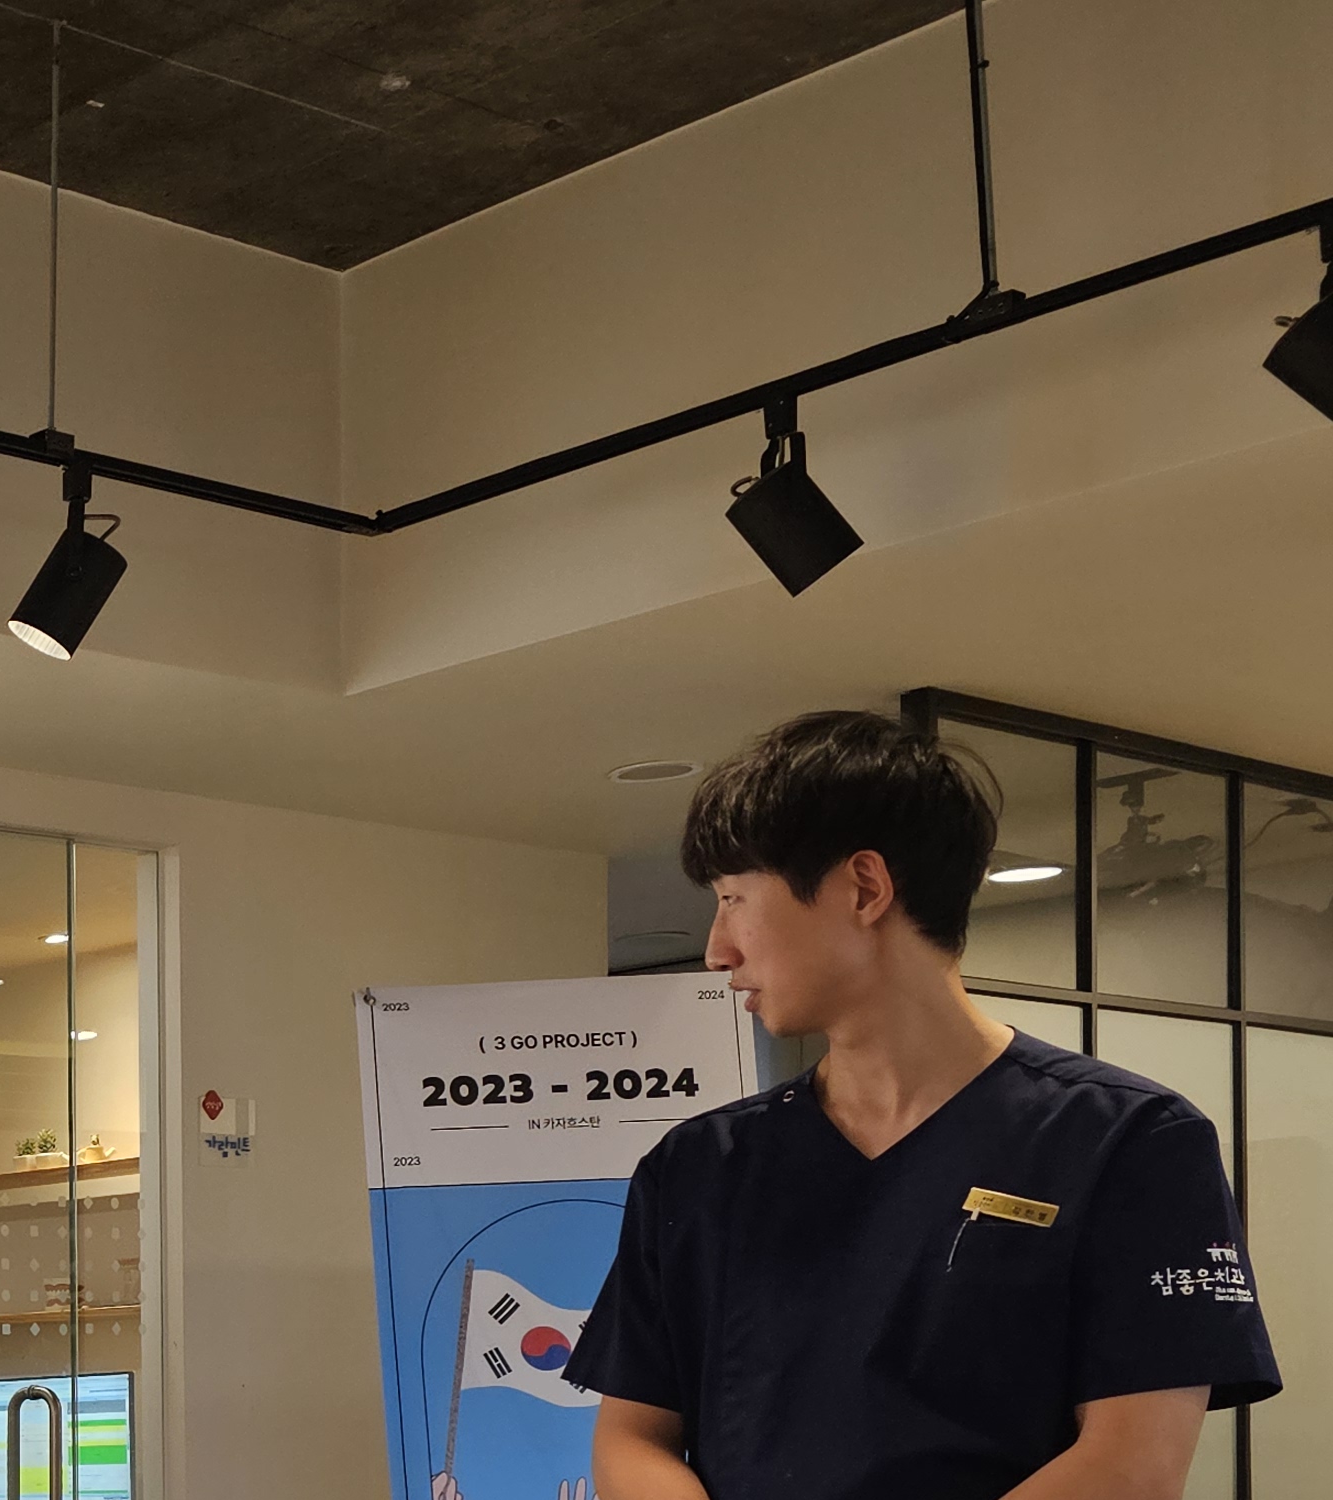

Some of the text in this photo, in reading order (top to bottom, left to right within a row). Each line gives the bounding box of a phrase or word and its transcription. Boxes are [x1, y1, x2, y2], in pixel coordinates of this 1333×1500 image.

[697, 990, 725, 1001] 2024
[382, 1002, 410, 1013] 2023
[494, 1036, 506, 1051] 3
[510, 1035, 538, 1050] GO
[542, 1031, 627, 1049] PROJECT
[422, 1067, 700, 1107] 2023 - 2024
[527, 1115, 601, 1130] IN 카자흐스탄
[393, 1156, 422, 1167] 2023
[1150, 1266, 1245, 1296] 참좋은치과
